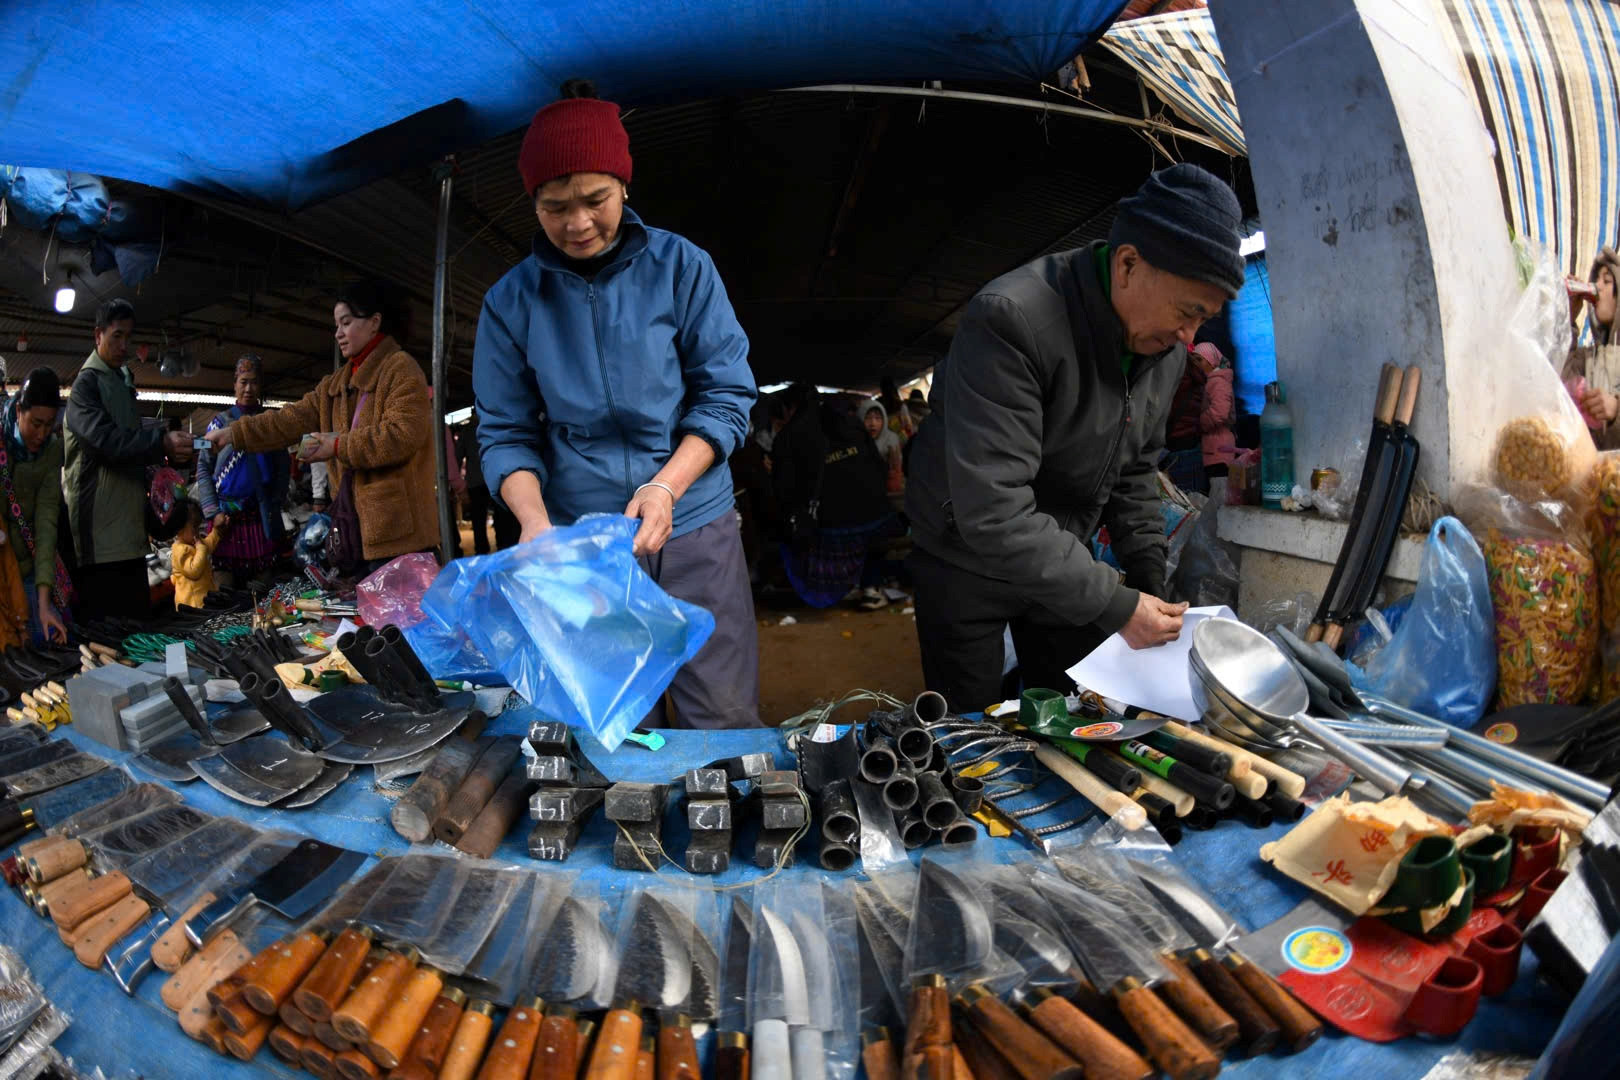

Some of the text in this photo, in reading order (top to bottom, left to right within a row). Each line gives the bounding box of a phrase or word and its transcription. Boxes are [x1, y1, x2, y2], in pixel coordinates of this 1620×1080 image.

[693, 769, 726, 792] 12
[529, 796, 565, 821] 14
[687, 803, 724, 830] 12
[528, 837, 565, 860] 14
